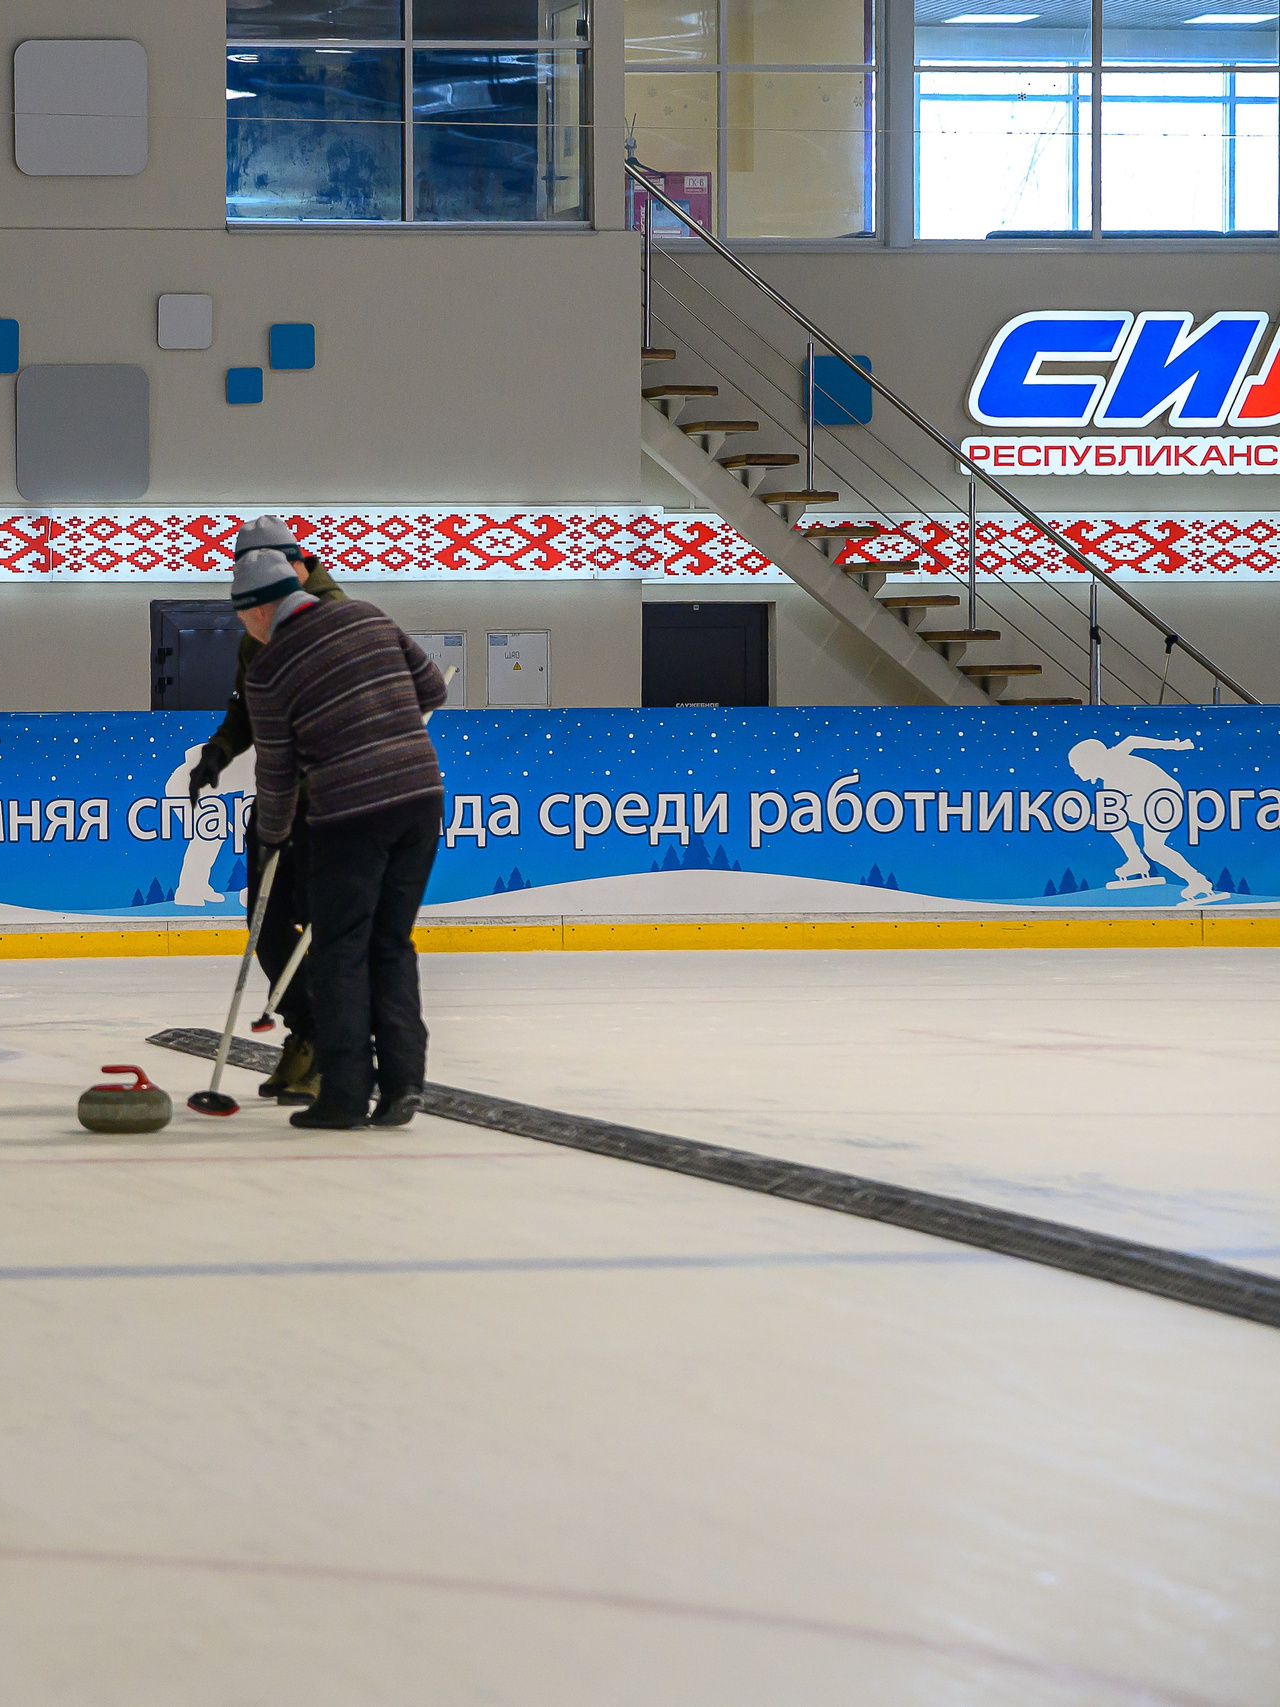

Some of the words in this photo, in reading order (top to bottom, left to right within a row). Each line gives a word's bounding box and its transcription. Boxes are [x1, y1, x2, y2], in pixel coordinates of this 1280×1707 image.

[969, 445, 1280, 467] РЕСПУБЛИКАНС
[539, 792, 728, 850] среди
[749, 773, 1130, 849] работников
[1144, 788, 1280, 847] орга
